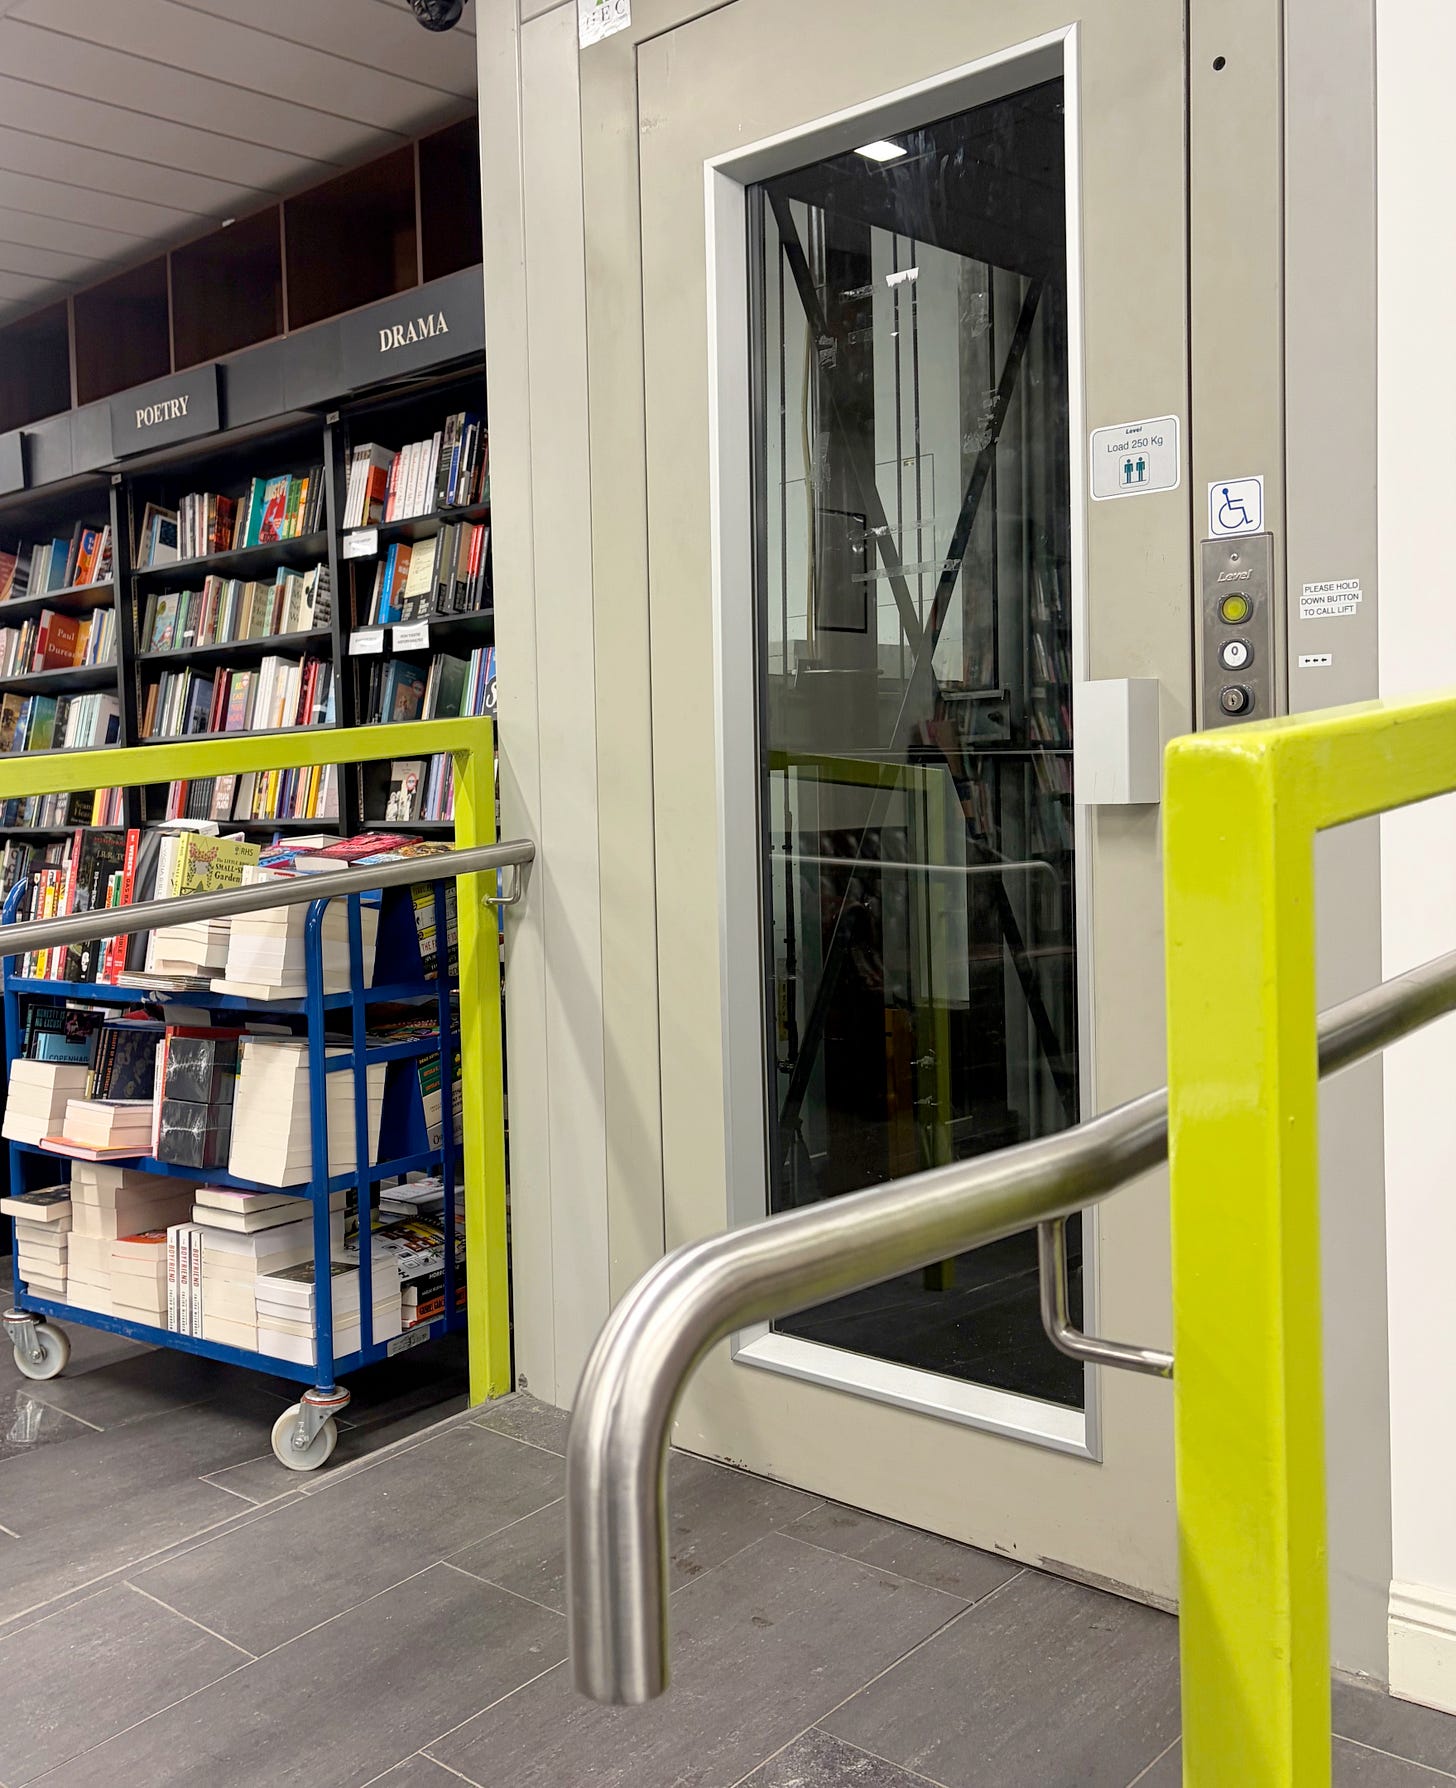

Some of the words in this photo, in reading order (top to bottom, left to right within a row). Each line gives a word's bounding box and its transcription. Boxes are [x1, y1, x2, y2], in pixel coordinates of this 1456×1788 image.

[379, 311, 449, 353] DRAMA
[135, 395, 190, 429] POETRY
[1125, 425, 1143, 435] Level
[1107, 440, 1130, 453] Load
[1131, 438, 1149, 449] 250
[1150, 435, 1164, 448] Kg
[1217, 568, 1252, 583] Level
[1304, 583, 1334, 594] PLEASE
[1336, 581, 1359, 591] HOLD
[1301, 595, 1326, 605] DOWN
[1327, 592, 1360, 603] BUTTON
[1303, 607, 1315, 616] TO
[1316, 606, 1336, 615] CALL
[1337, 604, 1354, 614] LIFT
[57, 628, 75, 641] Paul
[240, 847, 254, 856] RHS
[126, 844, 135, 877] WEBER'S
[124, 878, 132, 893] GAS
[168, 1244, 176, 1283] BOYFRIEND
